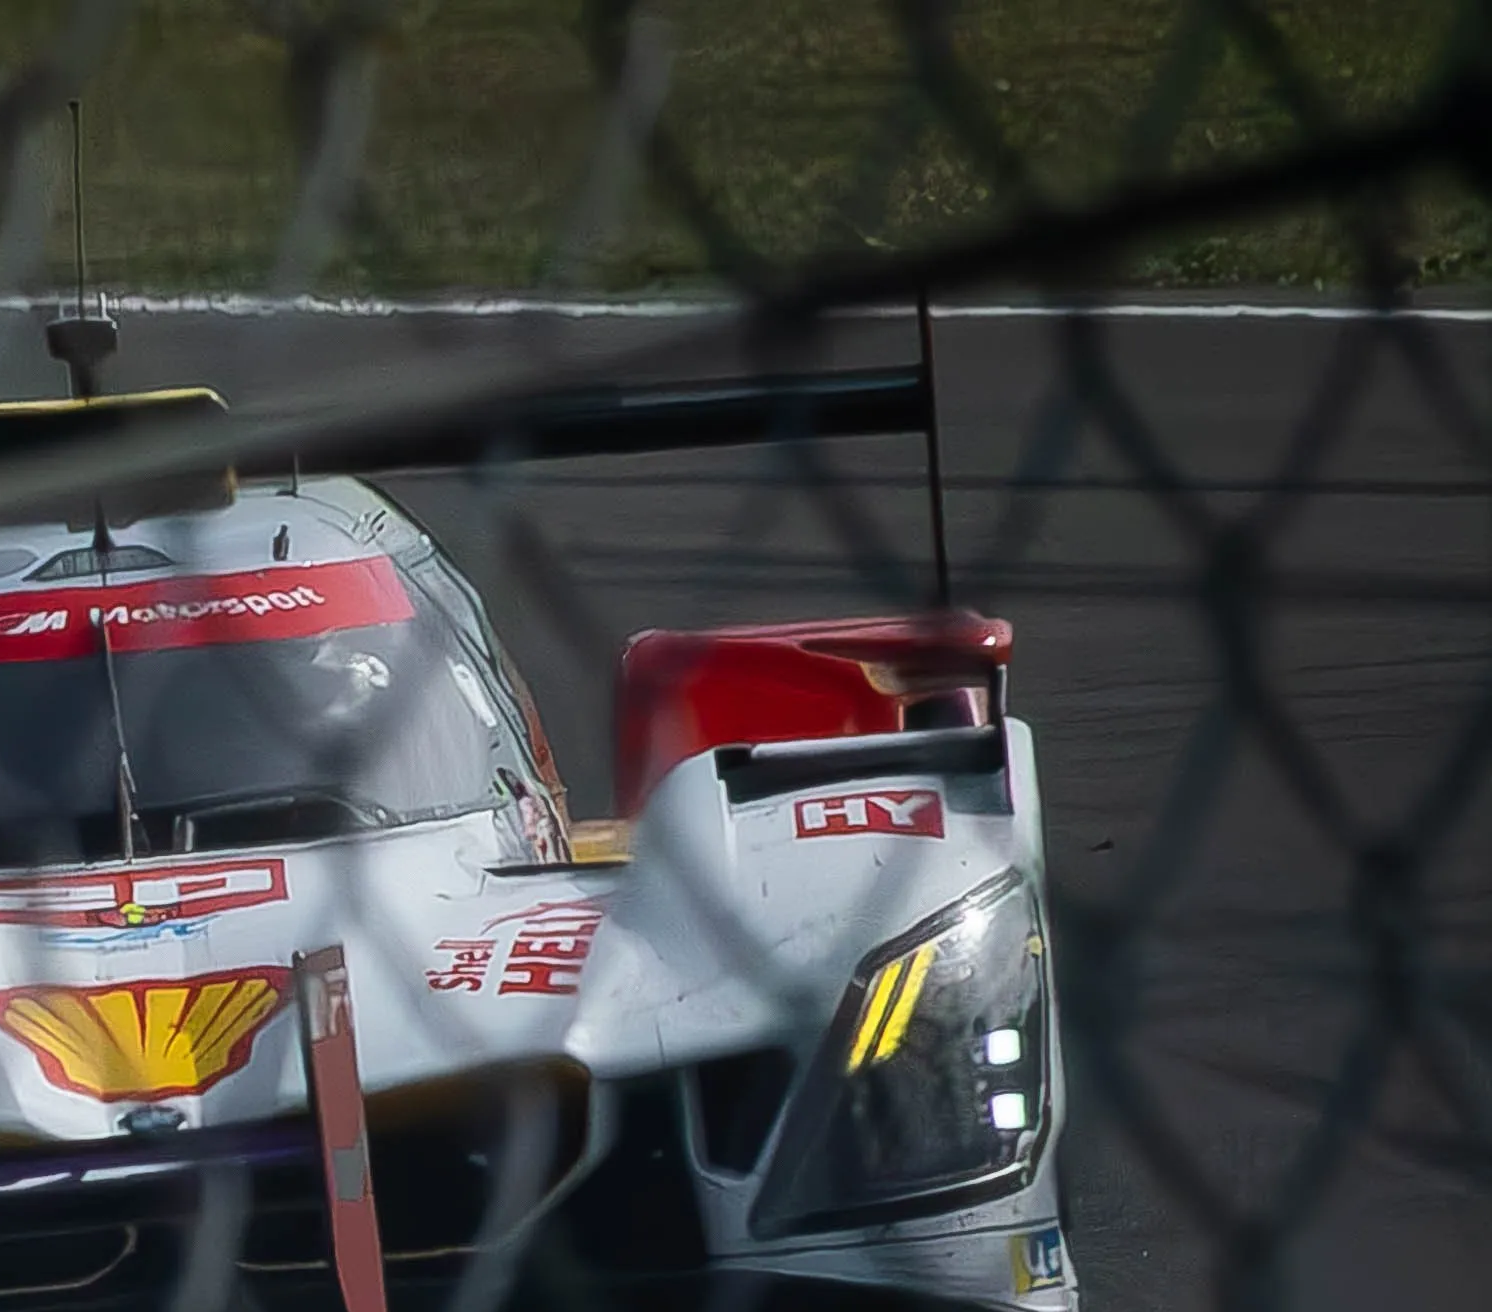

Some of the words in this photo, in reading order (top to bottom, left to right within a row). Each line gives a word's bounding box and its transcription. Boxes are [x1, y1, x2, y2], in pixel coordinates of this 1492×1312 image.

[90, 584, 326, 626] Motorsport
[802, 793, 934, 831] HY
[424, 939, 498, 993] Shell
